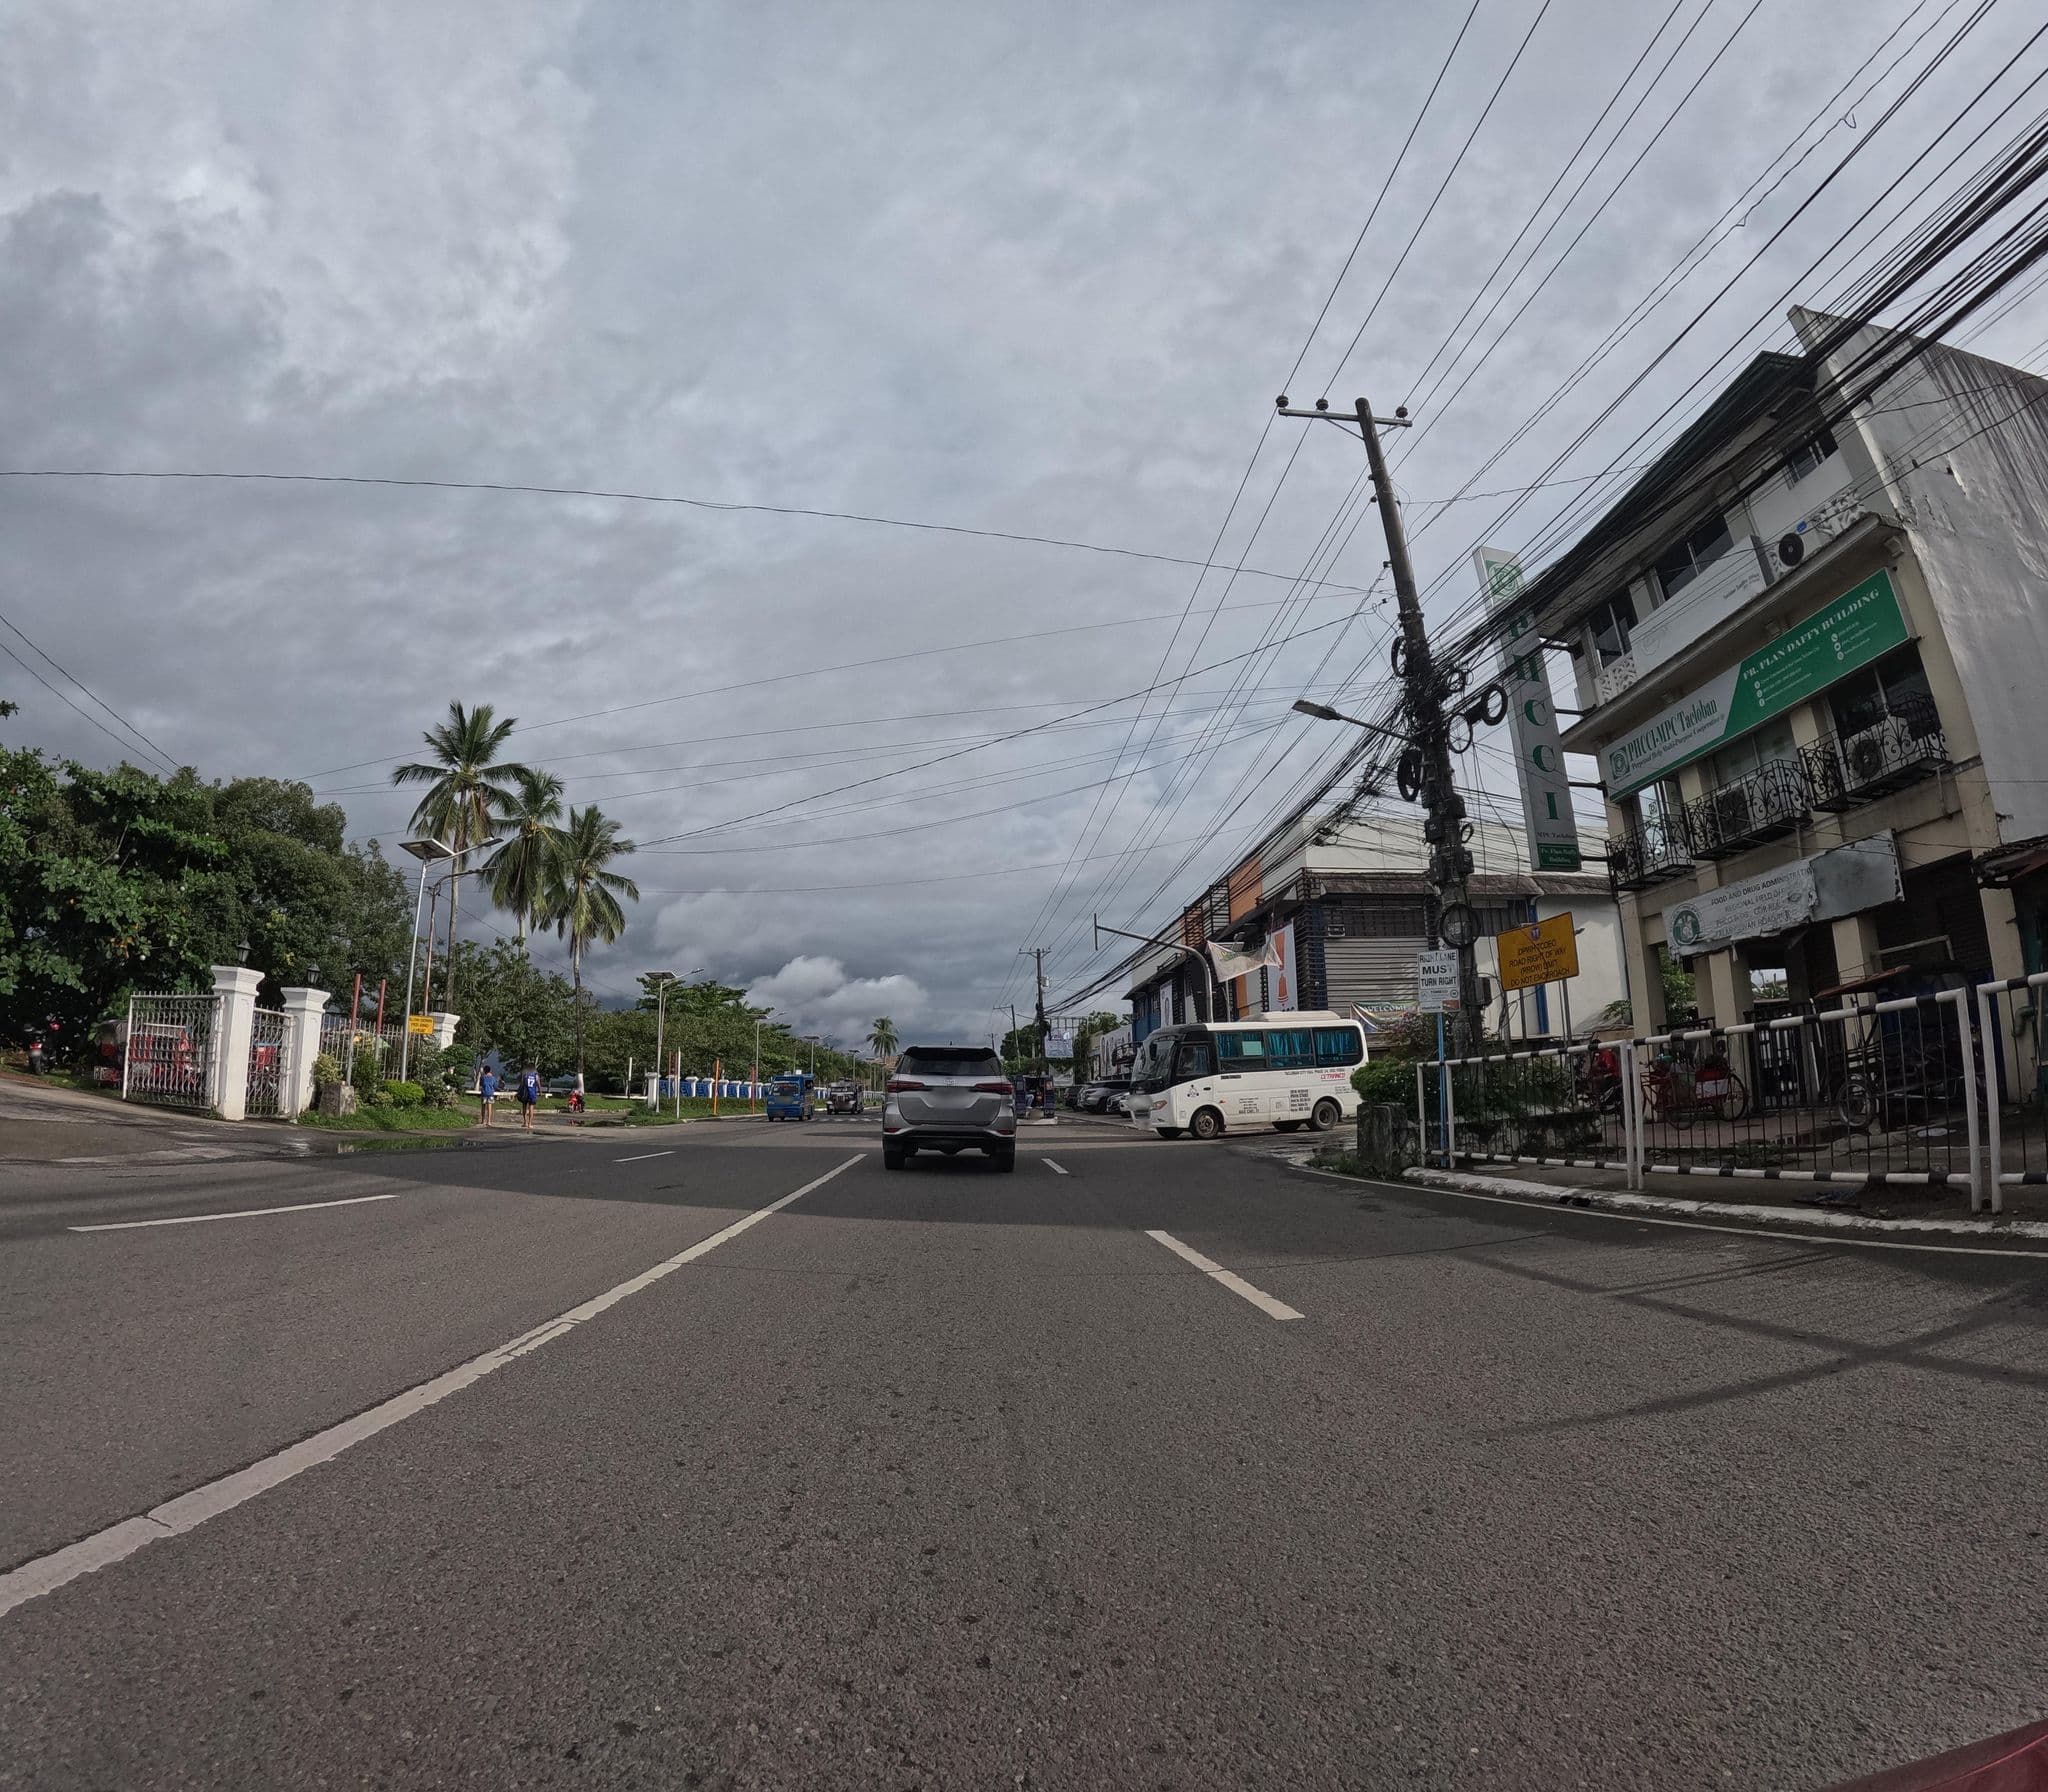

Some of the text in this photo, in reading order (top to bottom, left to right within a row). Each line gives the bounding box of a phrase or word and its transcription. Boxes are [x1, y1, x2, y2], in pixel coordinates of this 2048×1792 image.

[1821, 588, 1880, 631] BUILDING
[1627, 699, 1718, 761] PHCCI-MPC Tacloban
[1711, 895, 1728, 906] FOOD
[1728, 890, 1742, 900] AND
[1742, 884, 1761, 896] DRUG
[1508, 946, 1567, 968] ROAD RIGHT OF WAY
[1421, 975, 1457, 987] TURN RIGHT
[1510, 978, 1520, 987] DO
[1520, 975, 1533, 985] NOT
